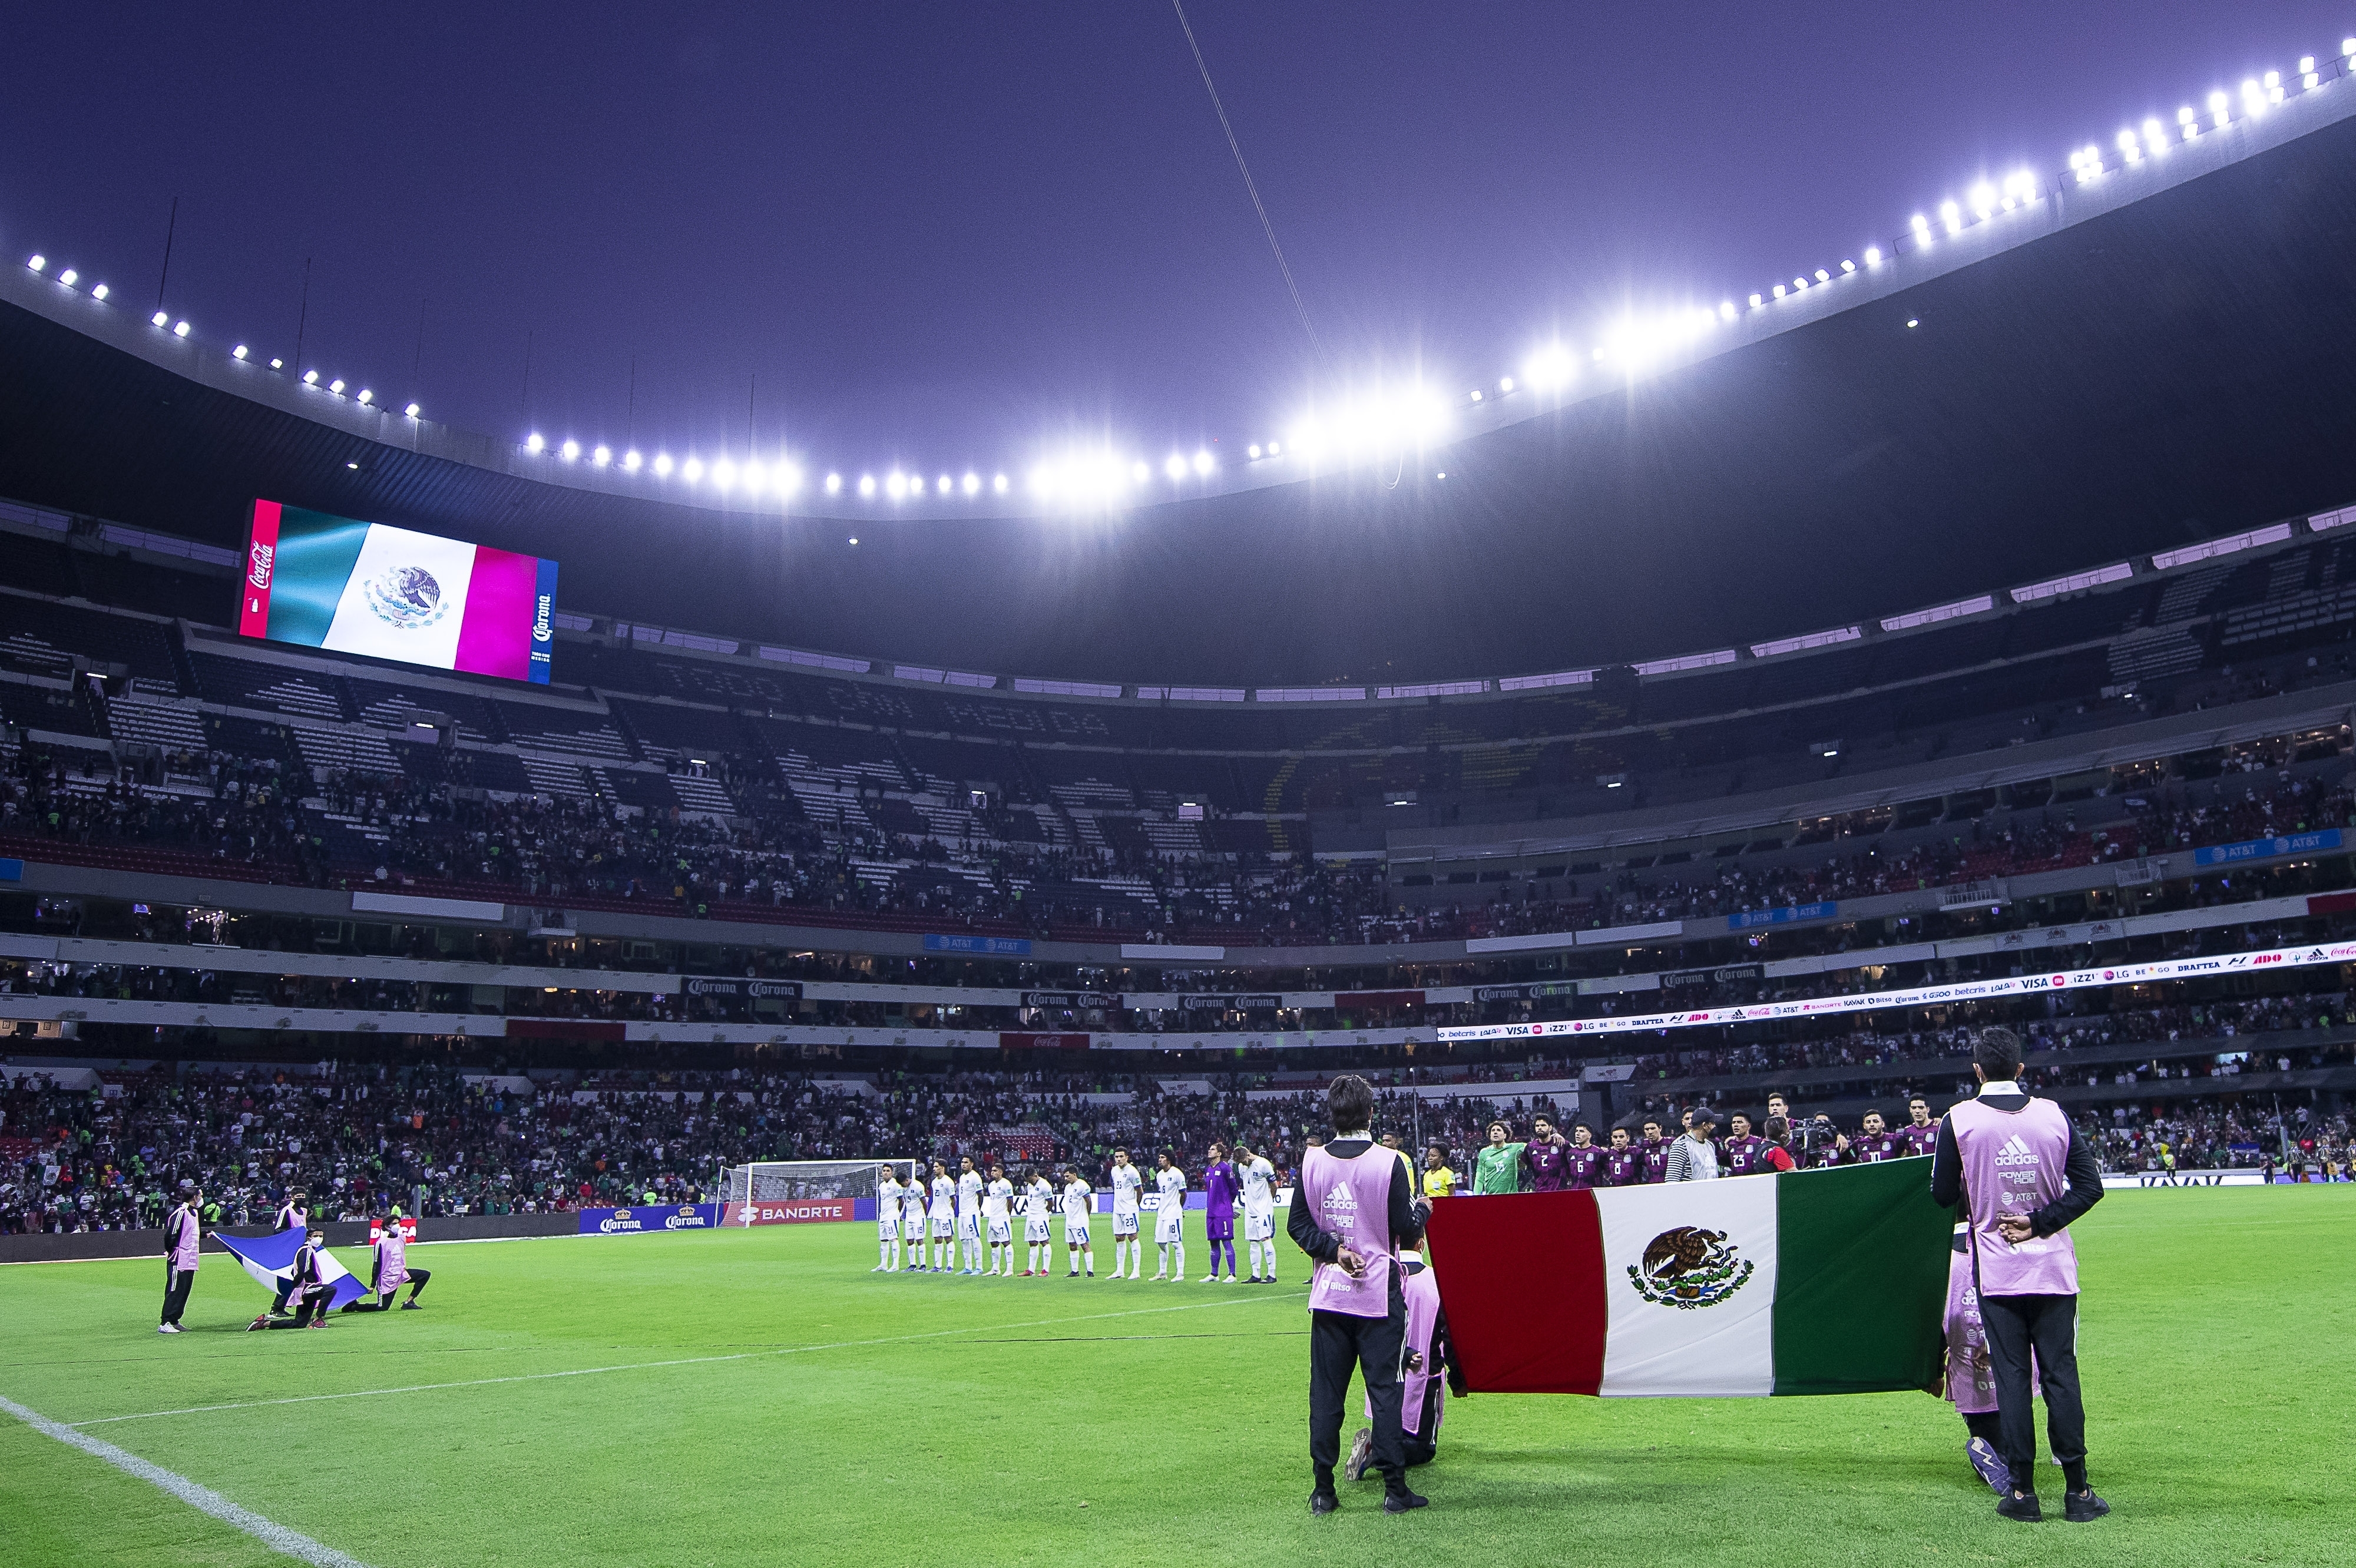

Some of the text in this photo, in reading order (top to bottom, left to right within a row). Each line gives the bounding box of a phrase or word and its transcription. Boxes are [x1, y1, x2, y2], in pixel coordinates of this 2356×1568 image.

[533, 594, 552, 641] Corona
[2292, 835, 2321, 848] AT&T
[2229, 845, 2256, 856] AT&T
[1800, 906, 1821, 916] AT&T
[1753, 912, 1773, 923] AT&T
[951, 939, 972, 948] AT&T
[998, 942, 1017, 951] AT&T
[2253, 954, 2282, 964] ADO
[2178, 961, 2221, 972] DRAFTEA
[1664, 974, 1705, 988] Corona
[1714, 969, 1756, 983] Corona
[688, 979, 736, 995] Corona
[1991, 983, 2010, 993] LALA
[2021, 978, 2049, 989] VISA
[748, 981, 795, 998] Corona
[1478, 988, 1520, 1002] Corona
[1529, 985, 1571, 999] Corona
[1955, 986, 1986, 995] betcris
[1027, 993, 1068, 1007] Corona
[1184, 997, 1225, 1011] Corona
[1235, 997, 1276, 1010] Corona
[1844, 998, 1865, 1007] KAVAK
[1687, 1013, 1709, 1022] ADO
[1505, 1027, 1529, 1036] VISA
[1541, 1155, 1548, 1167] 2
[1650, 1154, 1660, 1166] 14
[1733, 1155, 1745, 1167] 23
[1869, 1151, 1881, 1163] 10
[1994, 1153, 2039, 1166] adidas
[1577, 1160, 1583, 1173] 6
[1998, 1170, 2036, 1179] POWER
[1116, 1181, 1122, 1189] 23
[1210, 1179, 1213, 1188] 1
[2015, 1192, 2038, 1202] AT&T
[1323, 1199, 1358, 1210] adidas
[762, 1206, 843, 1220] BANORTE
[1326, 1214, 1354, 1222] POWER
[600, 1219, 642, 1233] Corona
[666, 1215, 705, 1229] Corona
[1126, 1218, 1134, 1227] 23
[1224, 1221, 1227, 1231] 1
[1263, 1219, 1268, 1228] 4
[1040, 1225, 1044, 1233] 6
[1169, 1225, 1176, 1233] 18
[2021, 1243, 2047, 1253] Bitso
[1330, 1282, 1351, 1292] Bitso
